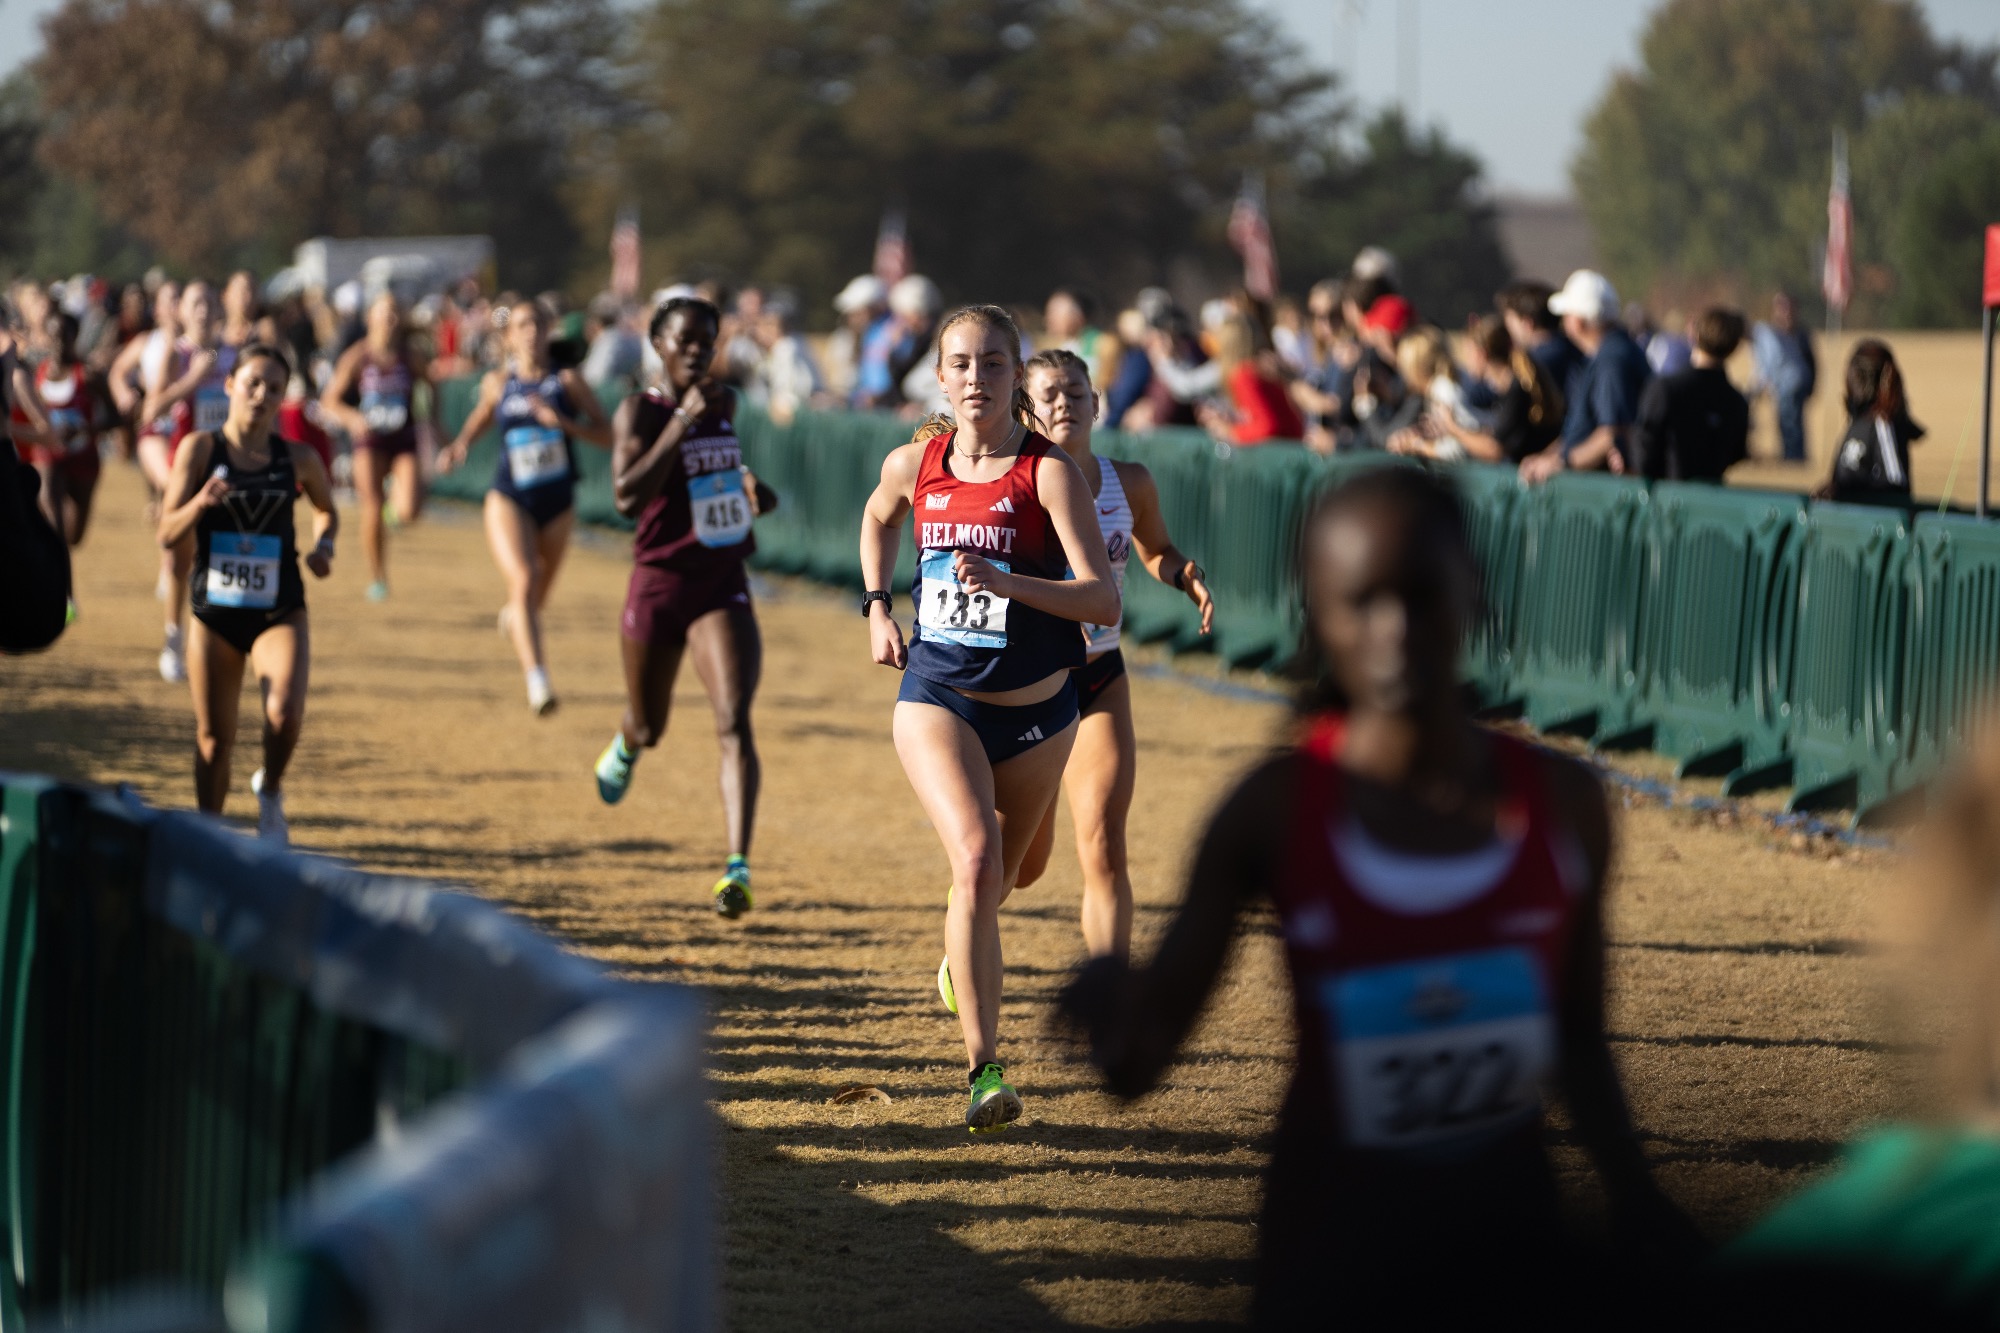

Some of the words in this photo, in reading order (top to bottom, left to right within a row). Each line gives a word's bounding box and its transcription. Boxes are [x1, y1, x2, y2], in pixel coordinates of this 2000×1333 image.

[705, 499, 742, 529] 416
[921, 522, 1017, 554] BELMONT
[220, 560, 266, 591] 585
